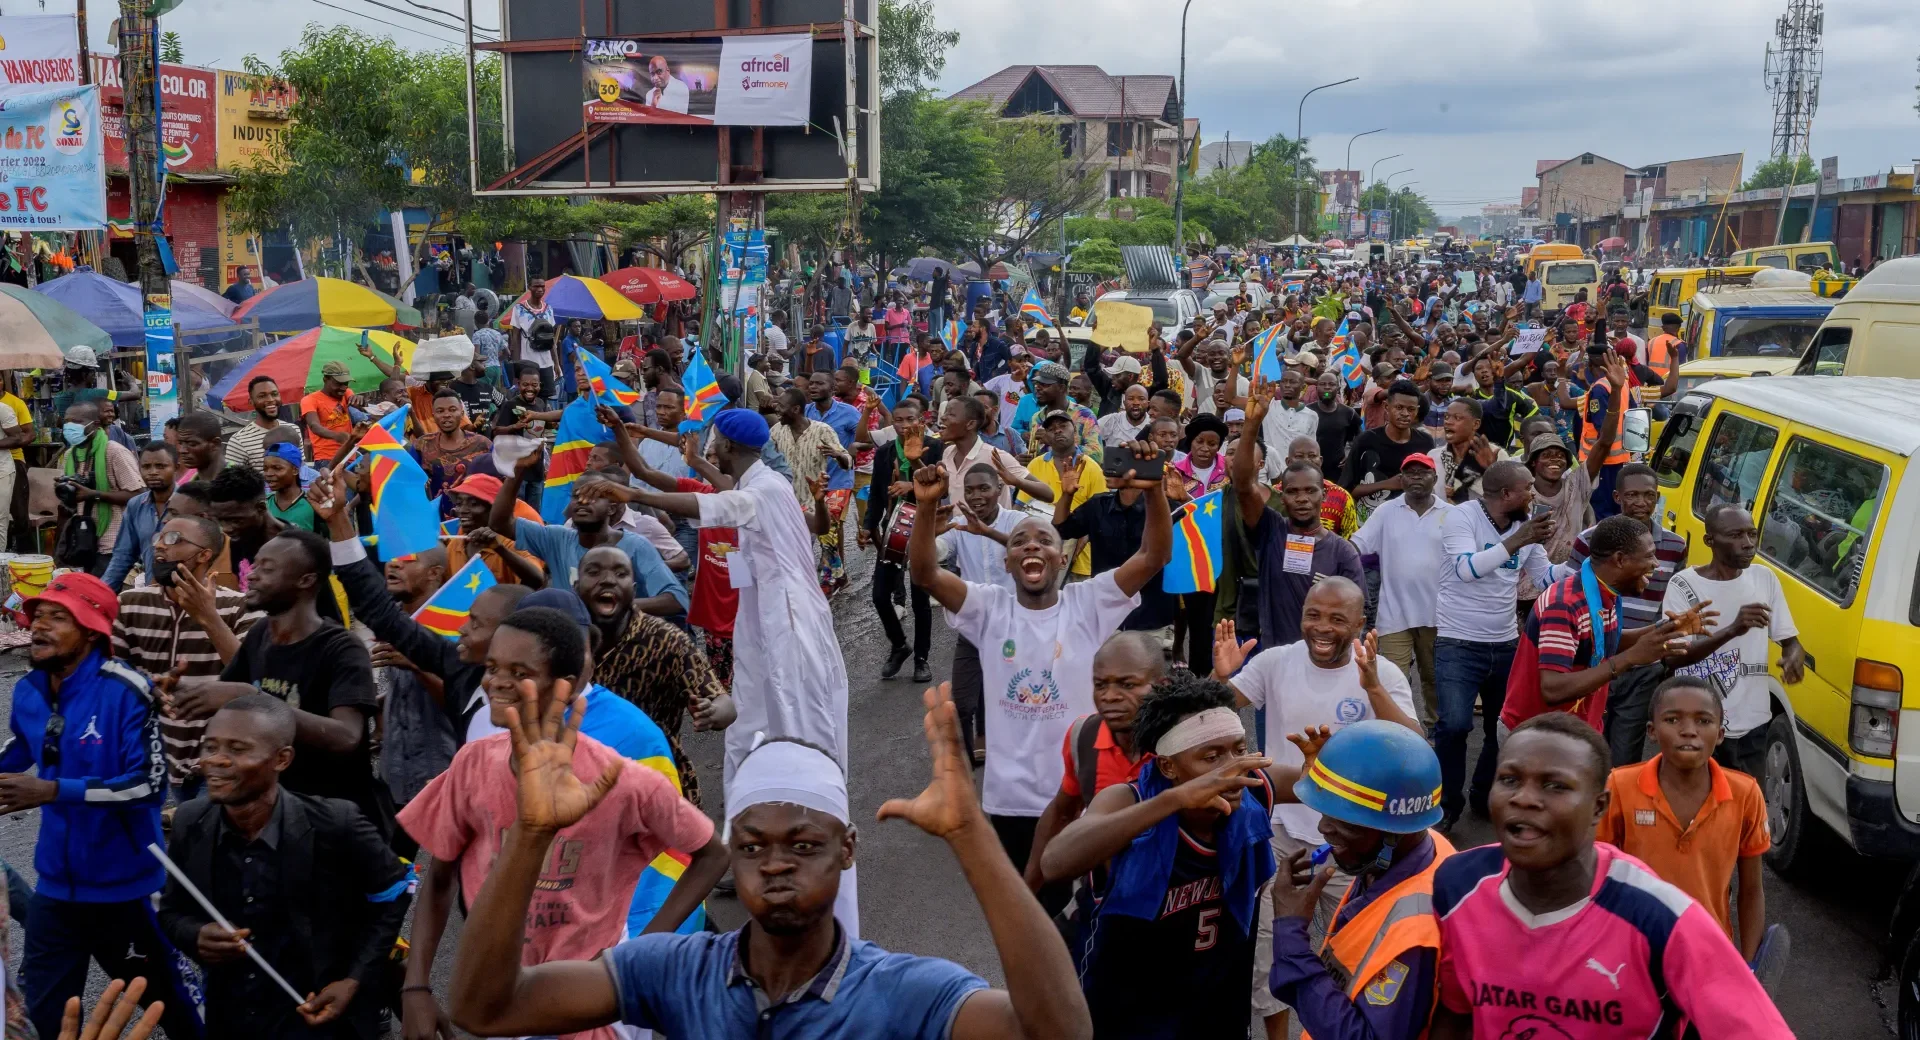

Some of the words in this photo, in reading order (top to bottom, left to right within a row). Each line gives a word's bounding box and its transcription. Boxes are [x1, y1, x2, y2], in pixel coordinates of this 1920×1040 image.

[587, 39, 638, 56] ZAIKO
[0, 58, 76, 84] VAINQUEURS
[741, 57, 790, 73] africell
[160, 74, 207, 99] COLOR
[25, 125, 45, 150] FC
[23, 156, 46, 167] 2022
[14, 185, 49, 213] FC
[1, 213, 28, 224] année
[37, 215, 57, 224] tous
[1068, 273, 1094, 283] TAUX
[1194, 908, 1222, 952] 5
[1544, 996, 1623, 1026] GANG
